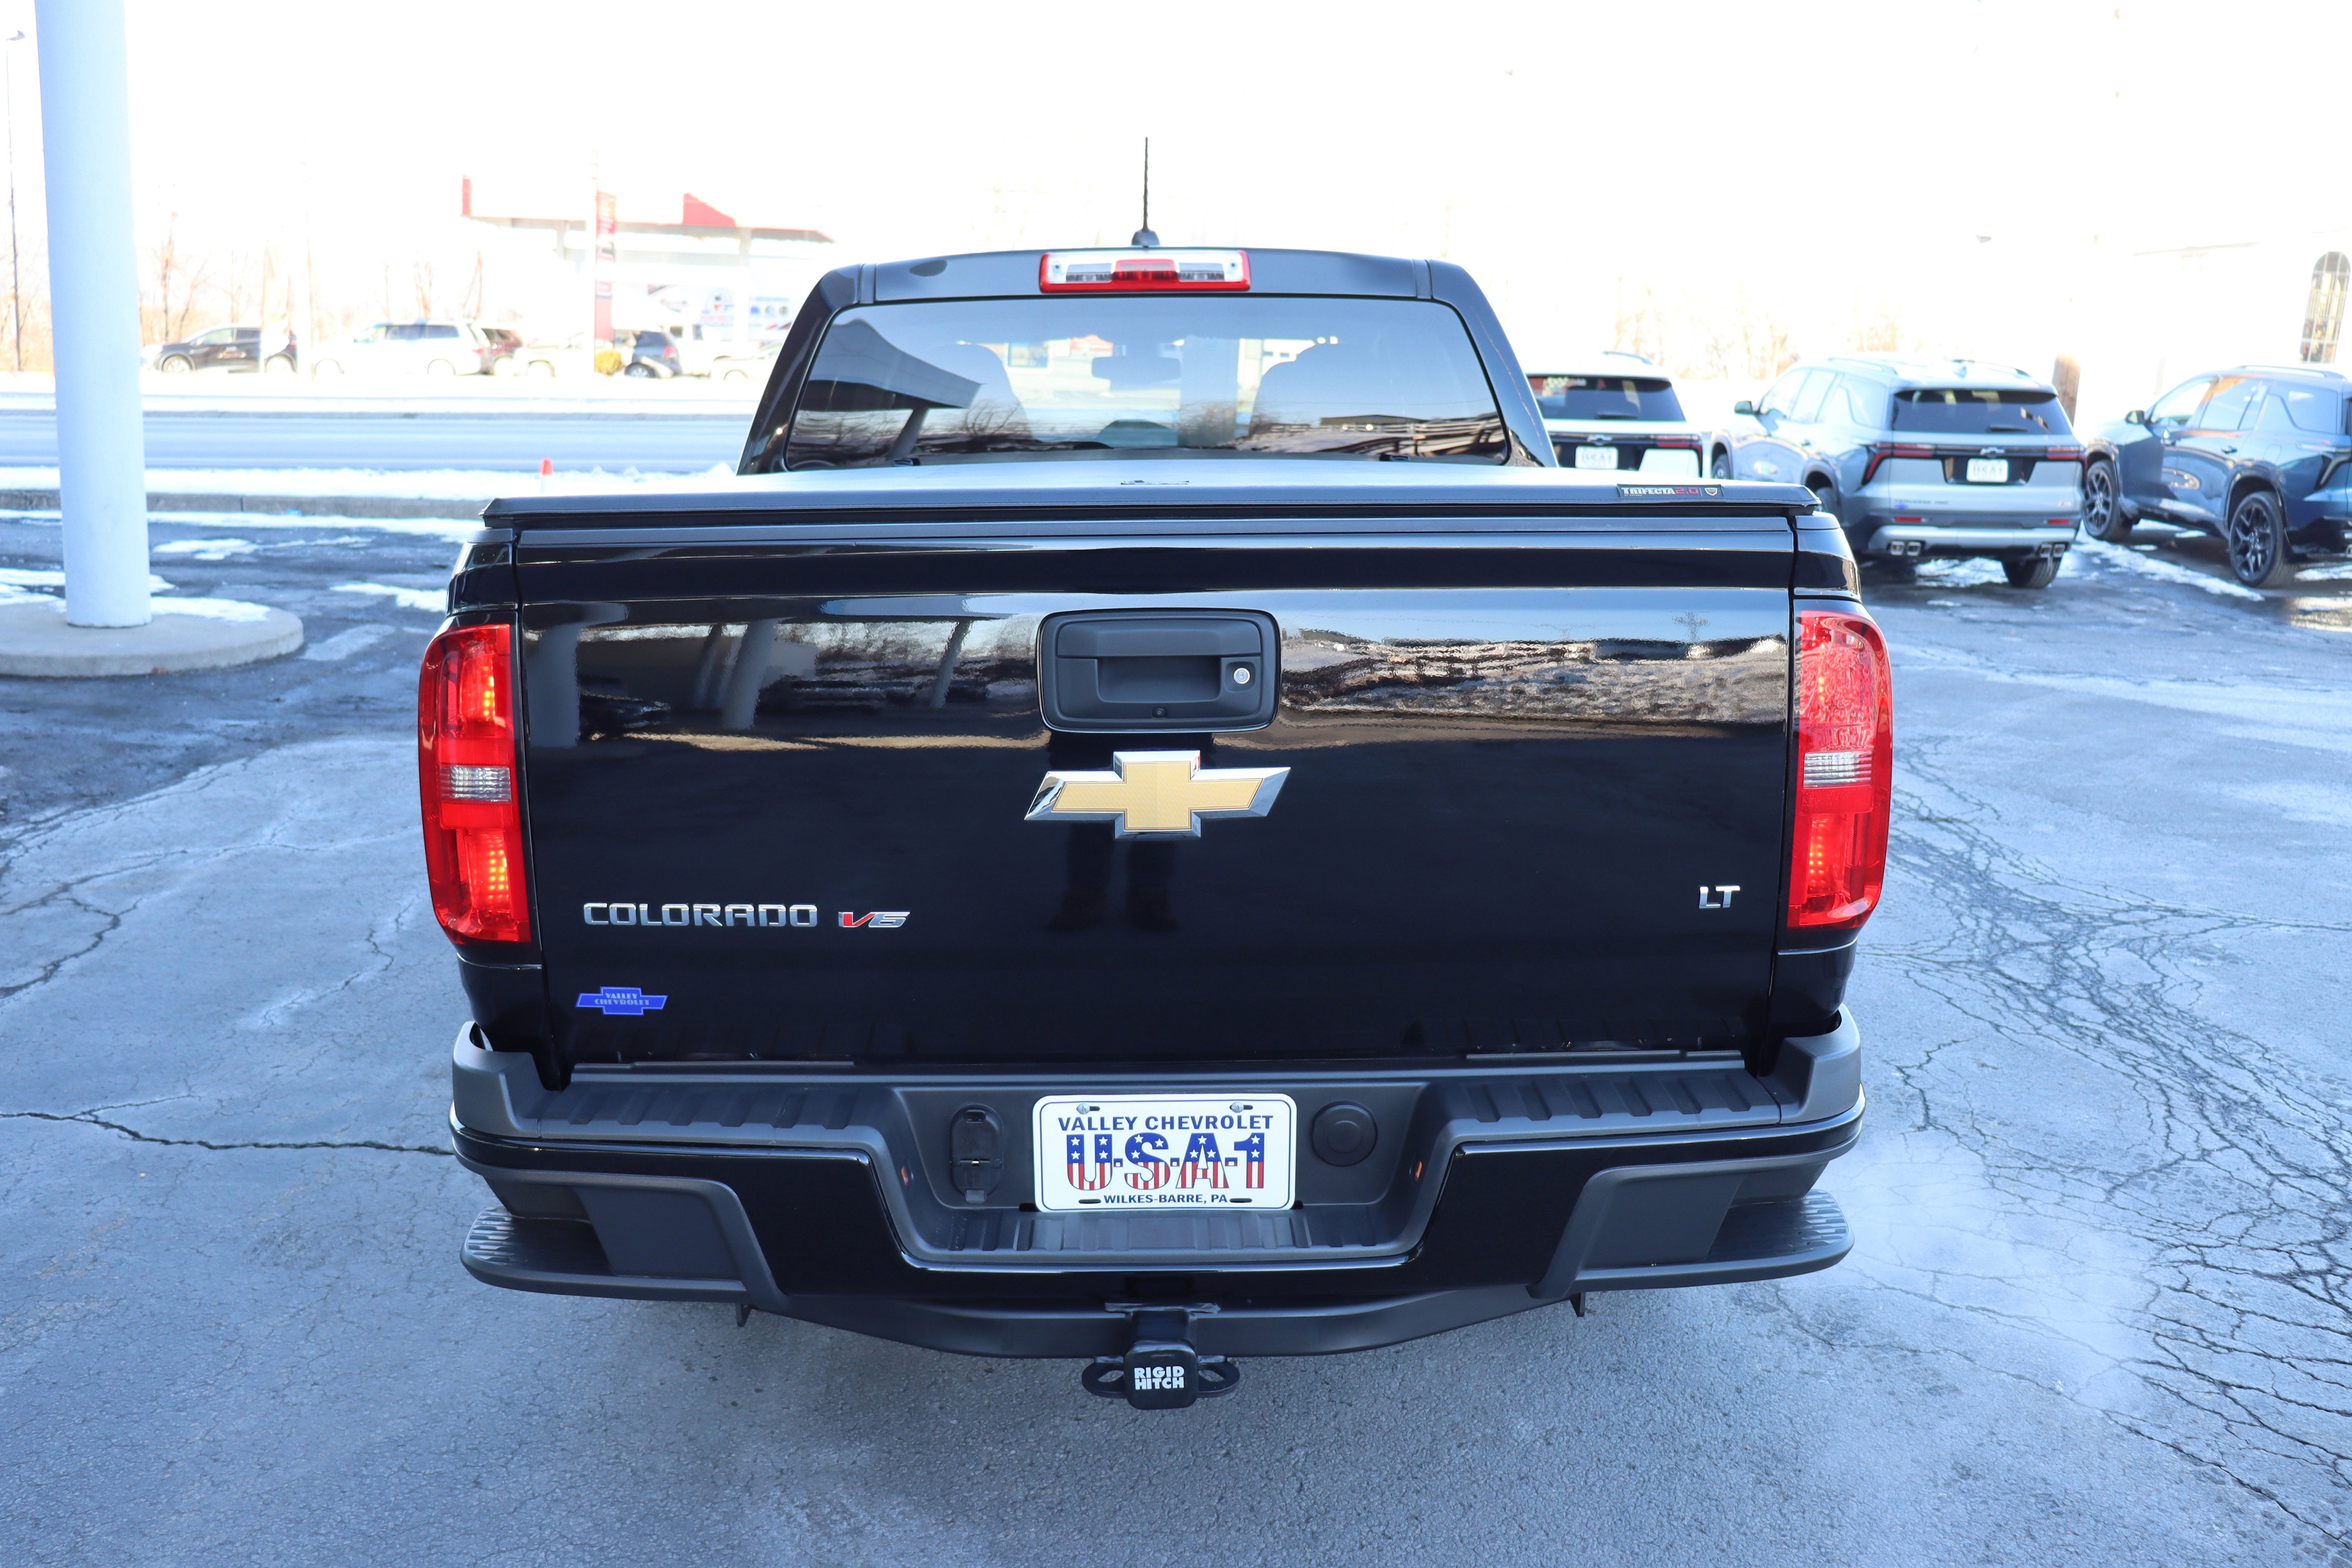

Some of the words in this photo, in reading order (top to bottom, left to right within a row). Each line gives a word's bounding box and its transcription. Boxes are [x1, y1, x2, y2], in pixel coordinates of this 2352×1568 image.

[1699, 885, 1741, 909] LT
[583, 903, 817, 927] COLORADO
[838, 910, 911, 928] V6
[1058, 1116, 1138, 1131] VALLEY
[1145, 1115, 1274, 1130] CHEVROLET
[1104, 1194, 1207, 1205] WILKES-BARRE,
[1211, 1194, 1228, 1203] PA
[1134, 1365, 1185, 1379] RIGID
[1134, 1376, 1185, 1390] HITCH
